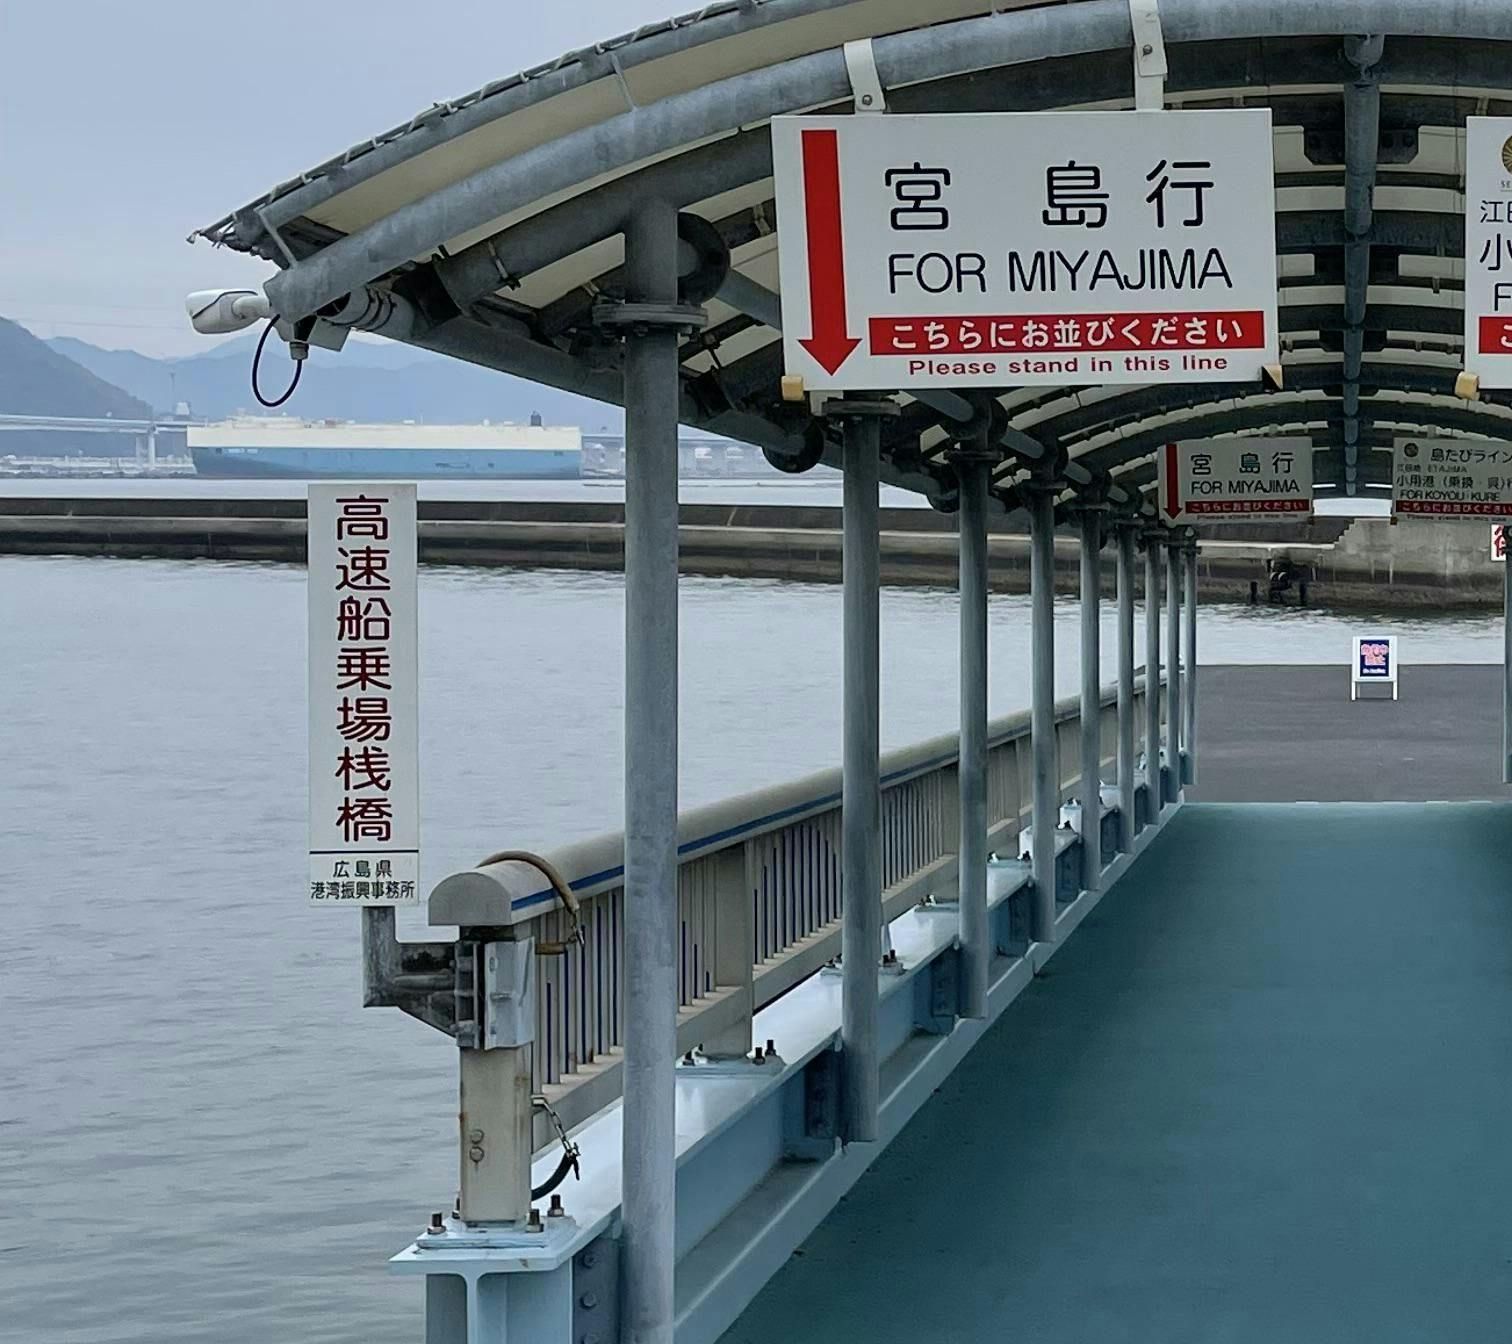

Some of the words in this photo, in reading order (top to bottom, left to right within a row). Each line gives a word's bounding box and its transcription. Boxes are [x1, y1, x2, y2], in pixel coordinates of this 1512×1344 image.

[888, 252, 987, 294] FOR
[1008, 248, 1233, 293] MIYAJIMA
[891, 316, 1243, 350] こちらにお並びください
[908, 359, 997, 376] Please
[1008, 357, 1079, 374] stand
[1090, 356, 1113, 372] in
[1123, 356, 1171, 372] this
[1182, 354, 1229, 371] line
[1191, 481, 1223, 495] FOR
[1228, 479, 1300, 494] MIYAJIMA
[335, 494, 393, 843] 高速船乗場桟橋
[332, 860, 393, 878] 広島県
[310, 880, 415, 900] 港湾振興事務所
